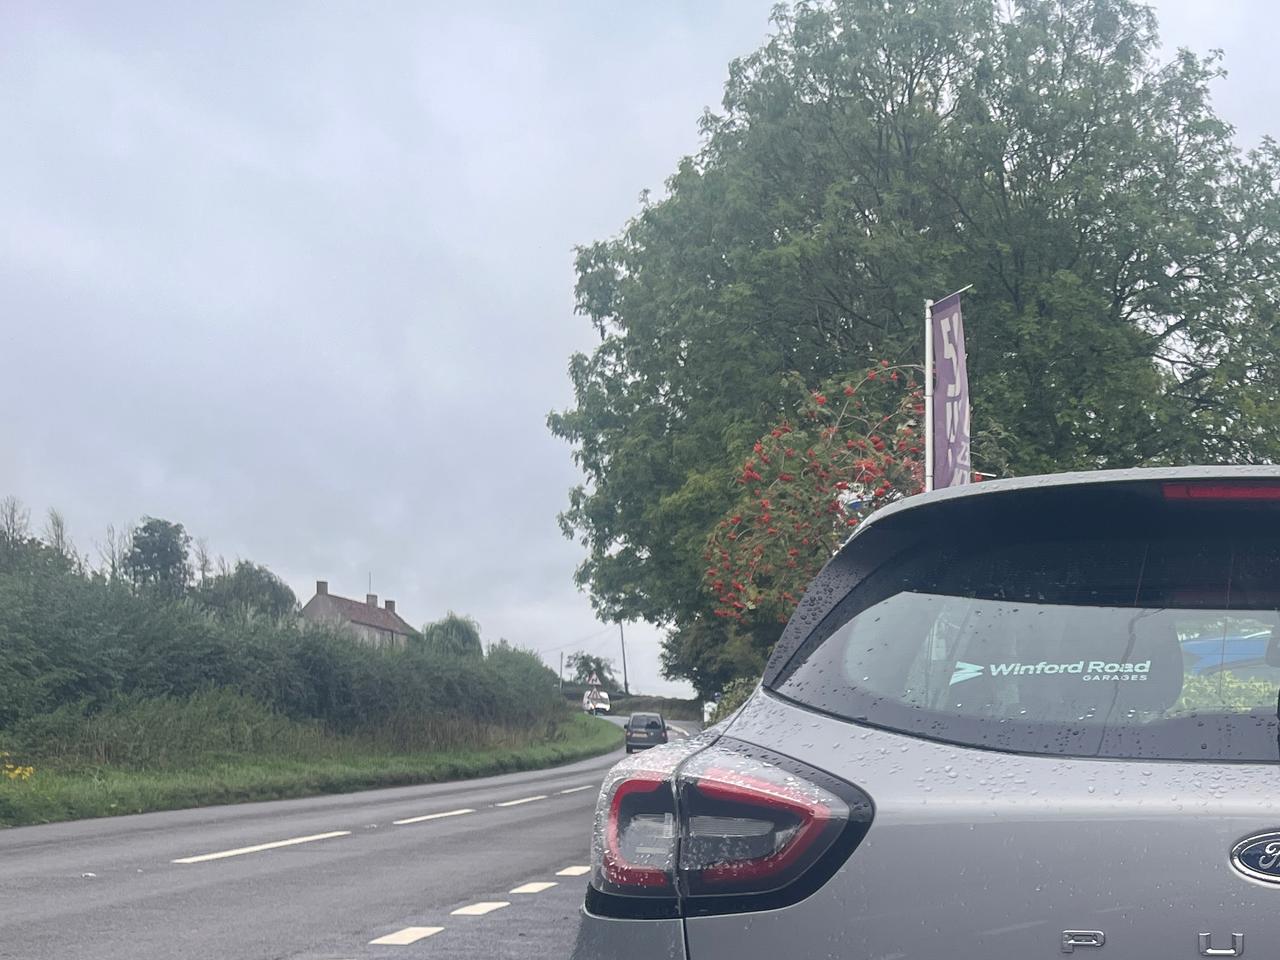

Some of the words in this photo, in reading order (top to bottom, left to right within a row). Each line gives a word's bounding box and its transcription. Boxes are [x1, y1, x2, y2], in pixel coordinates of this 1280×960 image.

[990, 661, 1083, 676] Winford
[1087, 660, 1151, 674] Road
[1082, 674, 1148, 682] GARAGES
